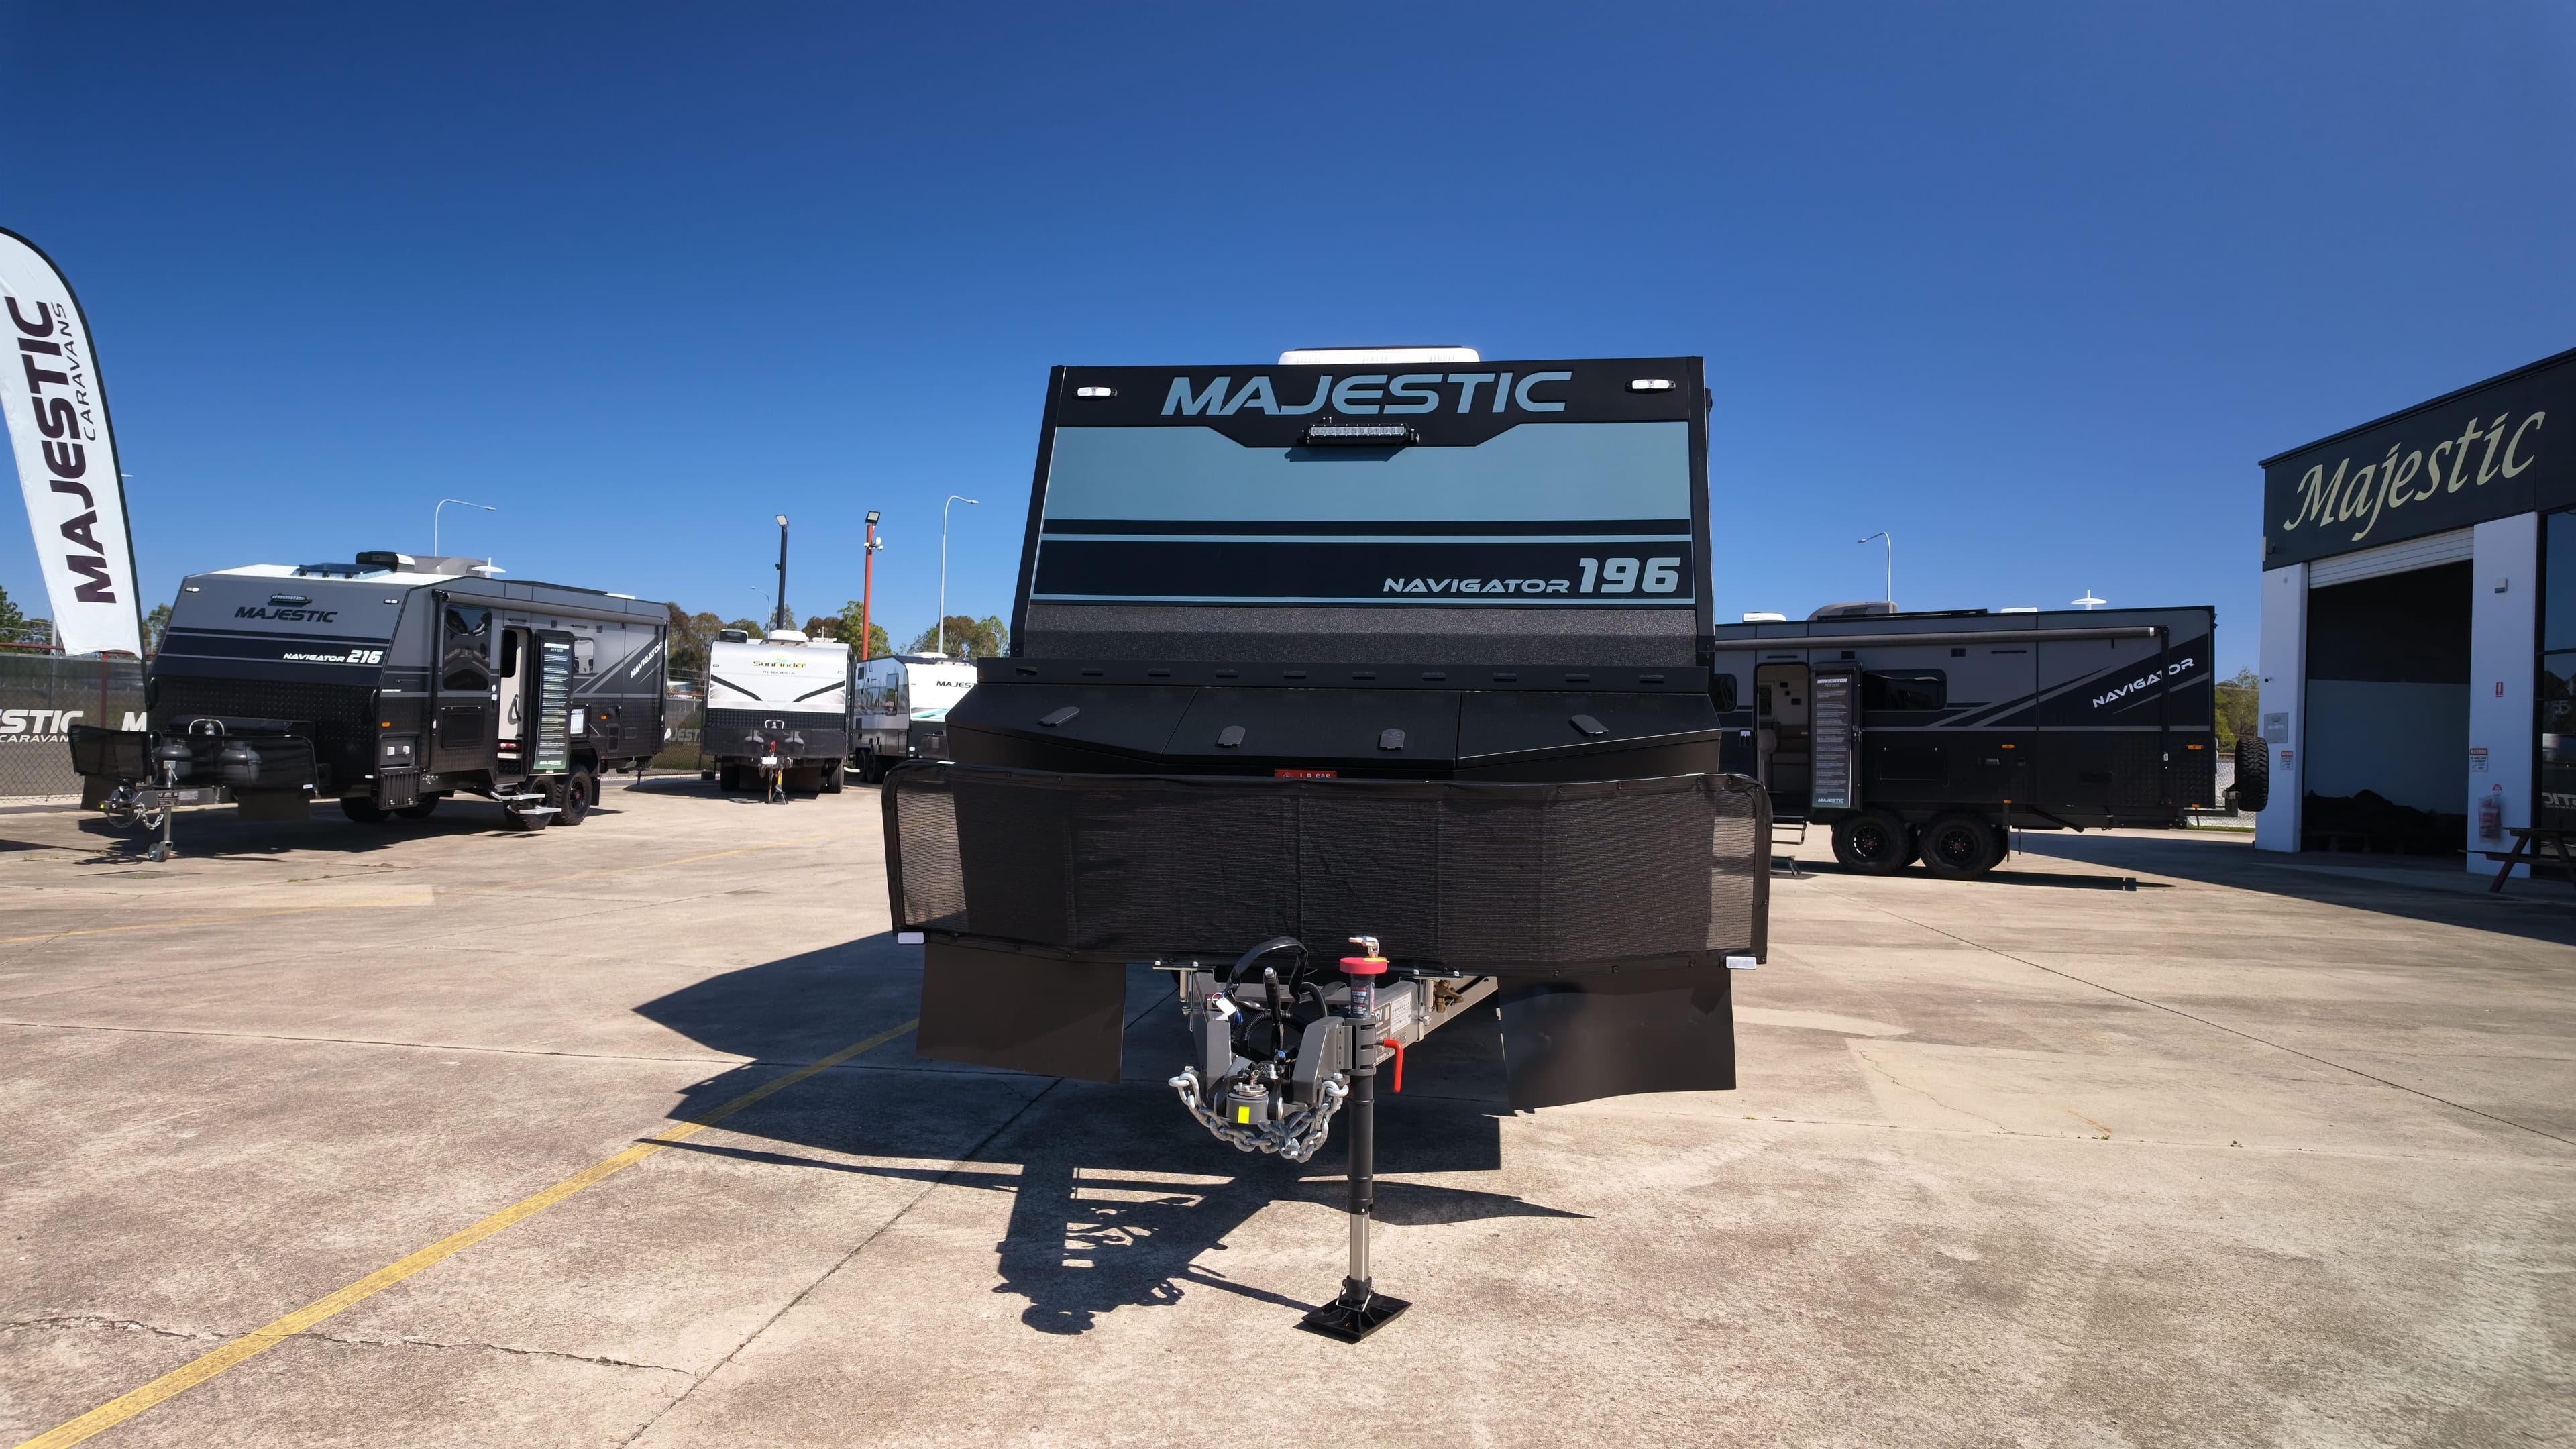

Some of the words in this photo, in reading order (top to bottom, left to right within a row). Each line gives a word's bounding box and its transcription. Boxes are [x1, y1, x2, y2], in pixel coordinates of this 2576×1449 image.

[50, 301, 96, 441] CARAVANS
[1161, 371, 1573, 415] MAJESTIC
[4, 295, 117, 604] MAJESTIC
[2282, 411, 2546, 542] Majestic
[1383, 578, 1570, 593] NAVIGATOR
[1578, 557, 1681, 593] 196
[235, 606, 338, 623] MAJESTIC
[283, 653, 345, 663] NAVIGATOR
[346, 649, 384, 664] 216
[0, 709, 84, 733] STIC
[0, 735, 70, 743] CARAVAN
